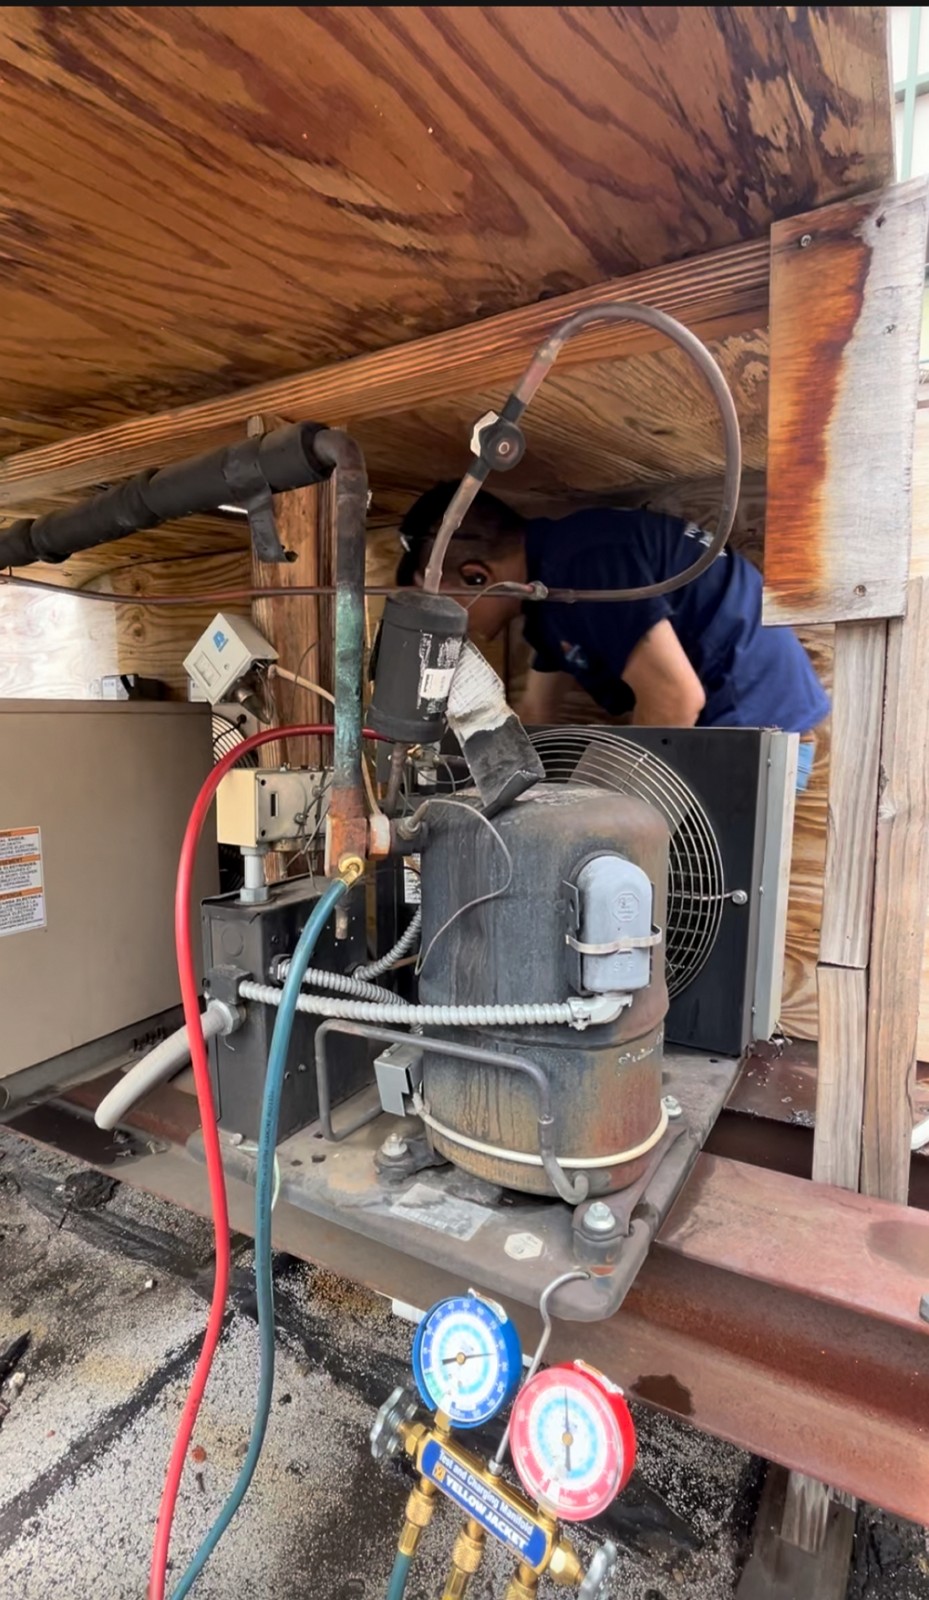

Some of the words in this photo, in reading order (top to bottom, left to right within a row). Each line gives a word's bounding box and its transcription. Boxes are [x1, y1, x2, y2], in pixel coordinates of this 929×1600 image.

[440, 1447, 454, 1469] Test
[453, 1463, 467, 1480] and
[467, 1474, 500, 1509] Charging
[499, 1501, 535, 1536] Manifold
[446, 1474, 487, 1516] YELLOW
[485, 1511, 529, 1550] JACKET
